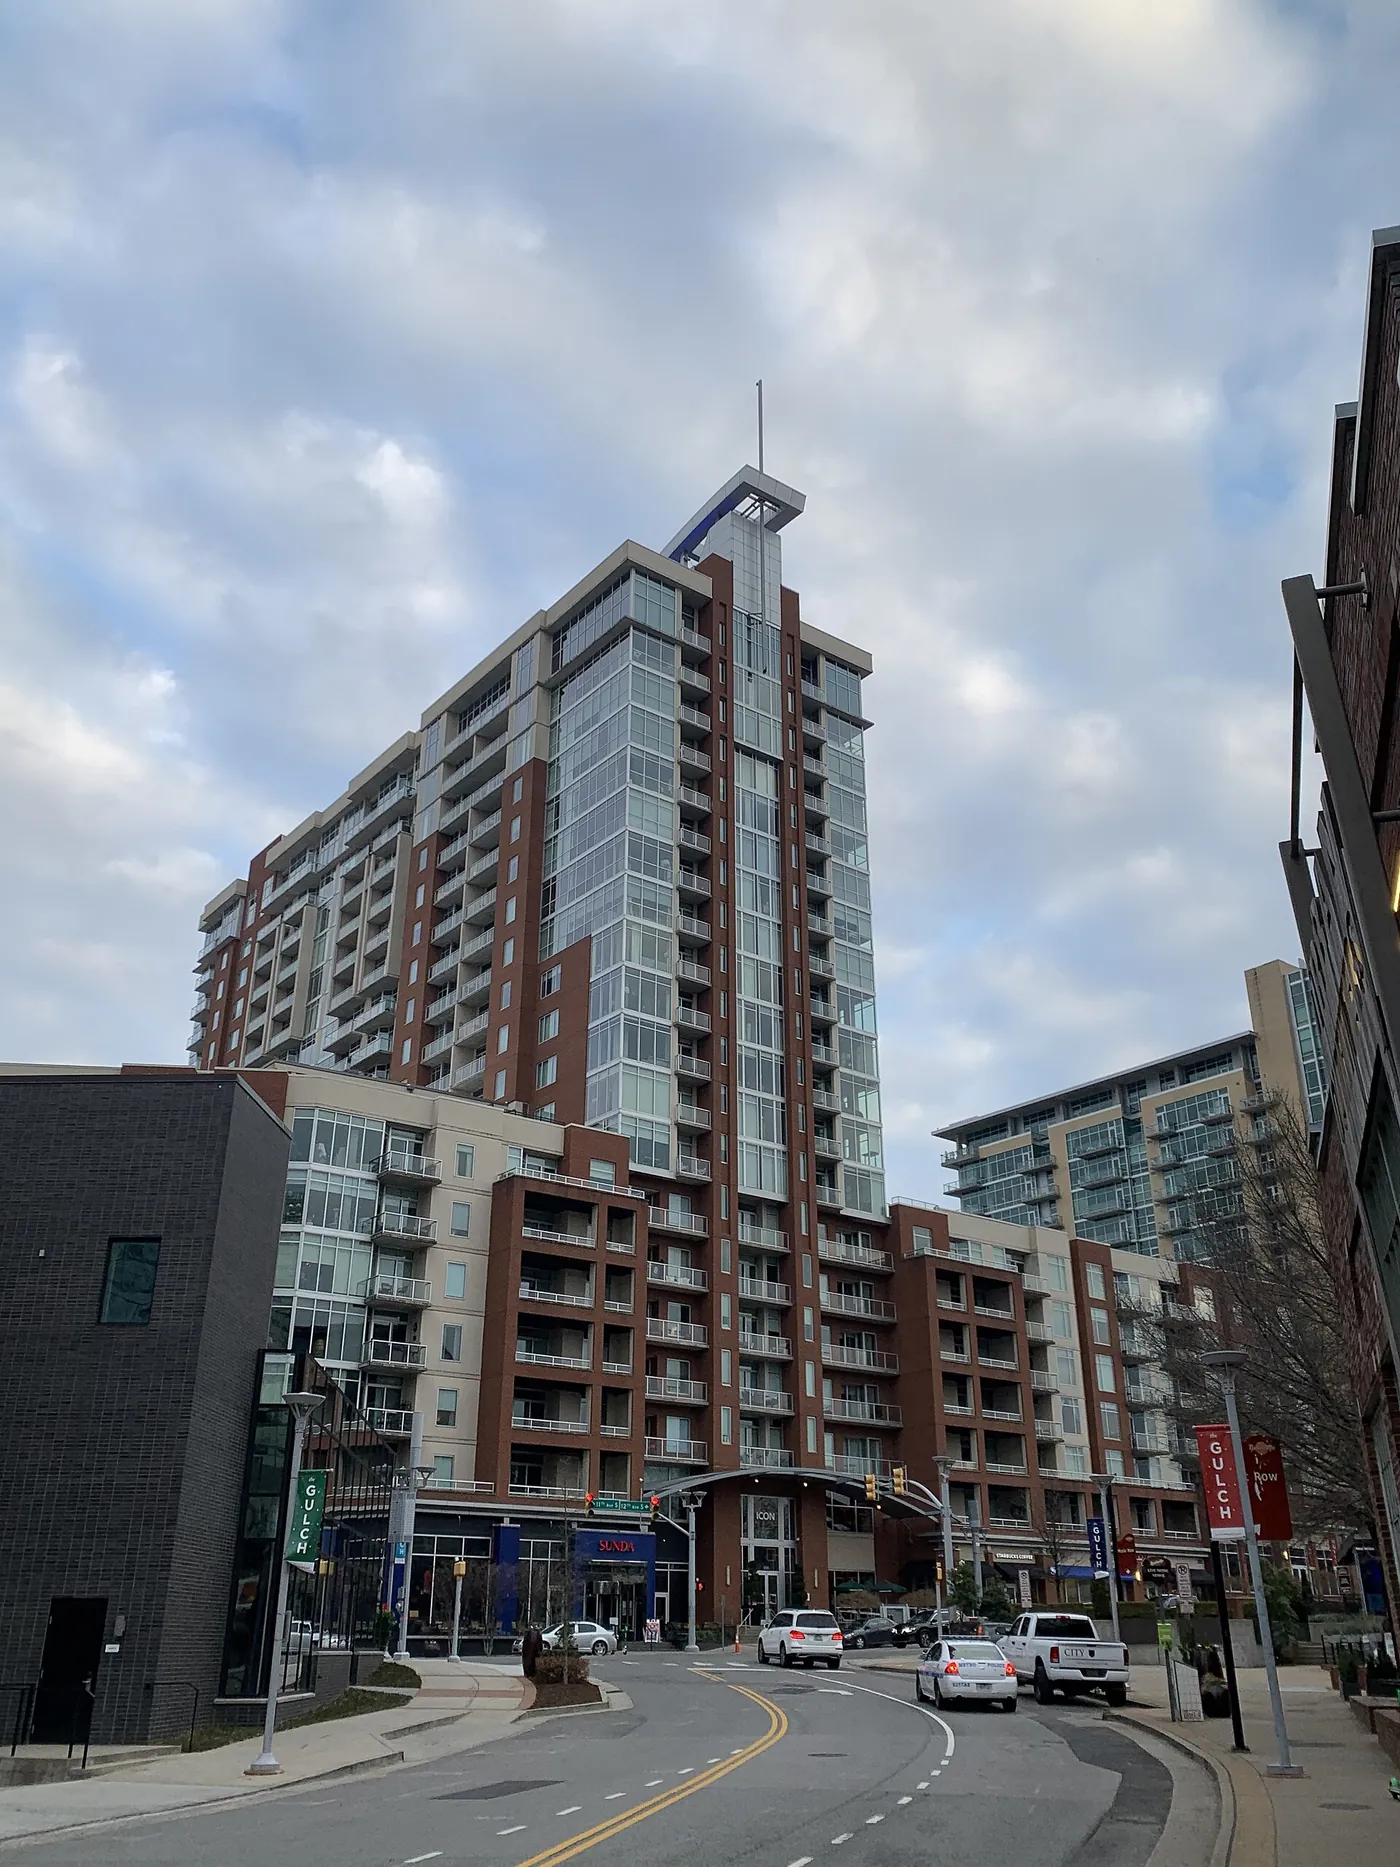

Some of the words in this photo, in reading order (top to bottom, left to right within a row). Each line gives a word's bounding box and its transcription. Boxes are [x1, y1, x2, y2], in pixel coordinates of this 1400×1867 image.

[1209, 1441, 1232, 1519] GULCH
[296, 1484, 317, 1554] GULCH
[756, 1511, 776, 1521] ICON
[599, 1540, 635, 1552] SUNDA
[1092, 1526, 1103, 1568] GULCH
[1064, 1648, 1085, 1657] CITY
